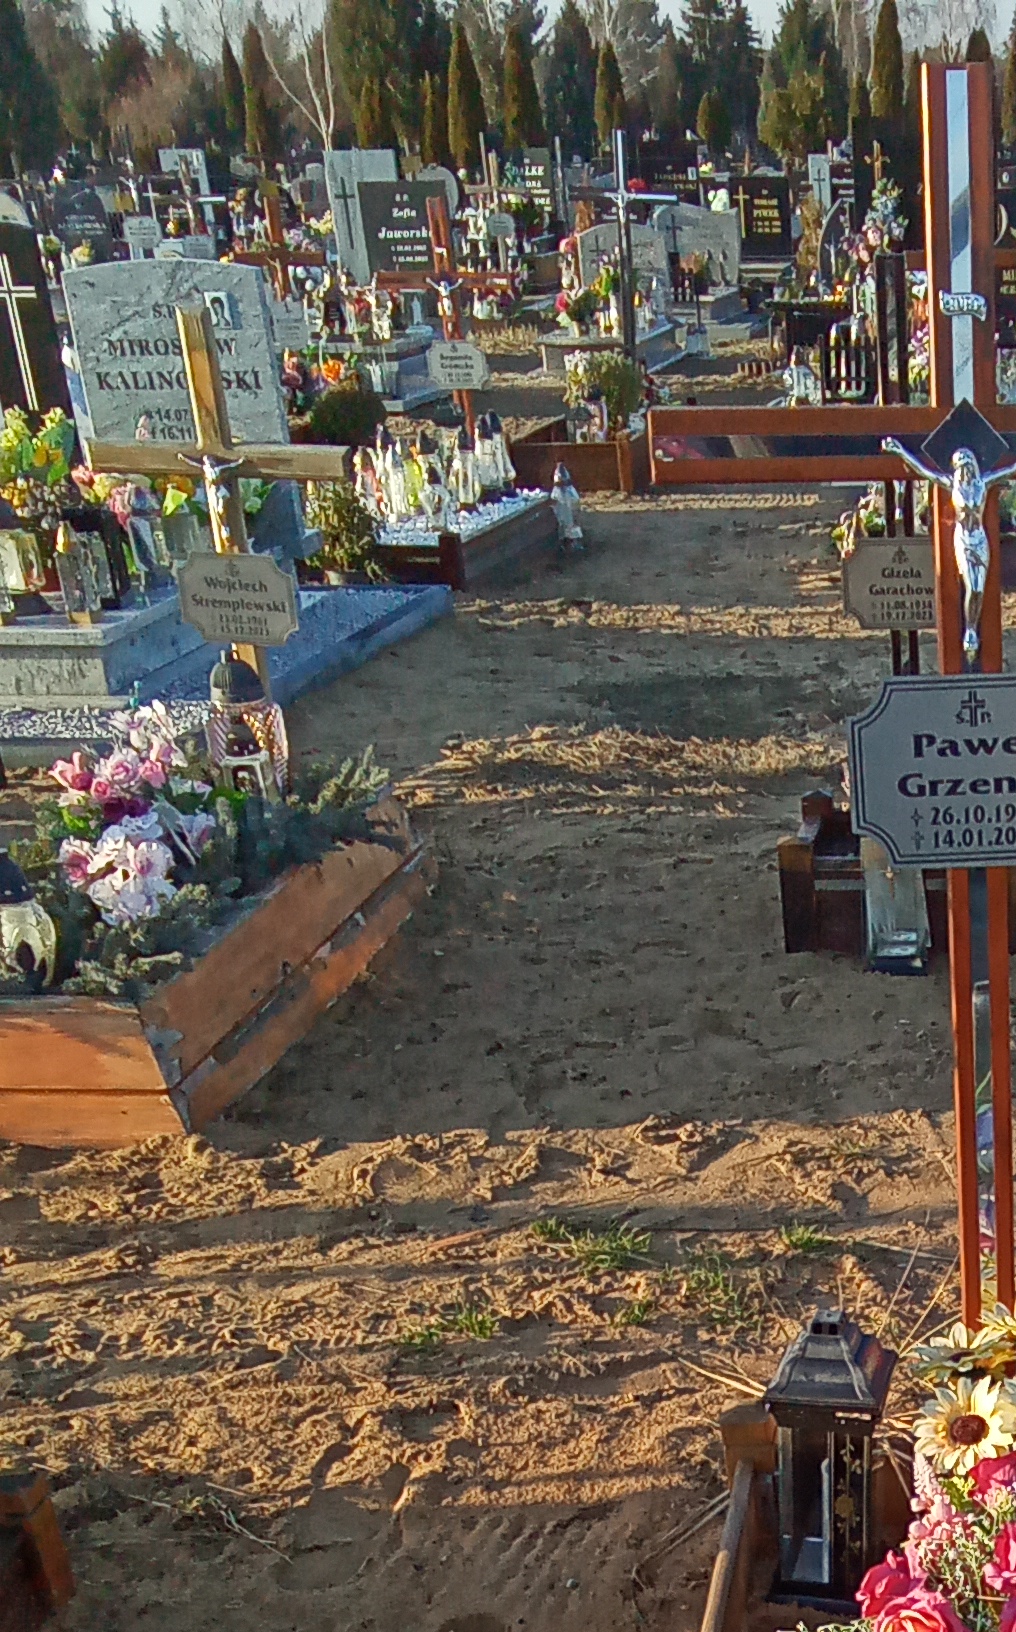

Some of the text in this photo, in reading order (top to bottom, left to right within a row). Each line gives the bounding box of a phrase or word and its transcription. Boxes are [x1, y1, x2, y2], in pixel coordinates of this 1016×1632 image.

[106, 337, 237, 358] MIROSW
[95, 366, 263, 391] KALINOSKI
[882, 567, 922, 580] Gizela
[203, 576, 268, 595] Wojciech
[869, 583, 934, 597] Garachow
